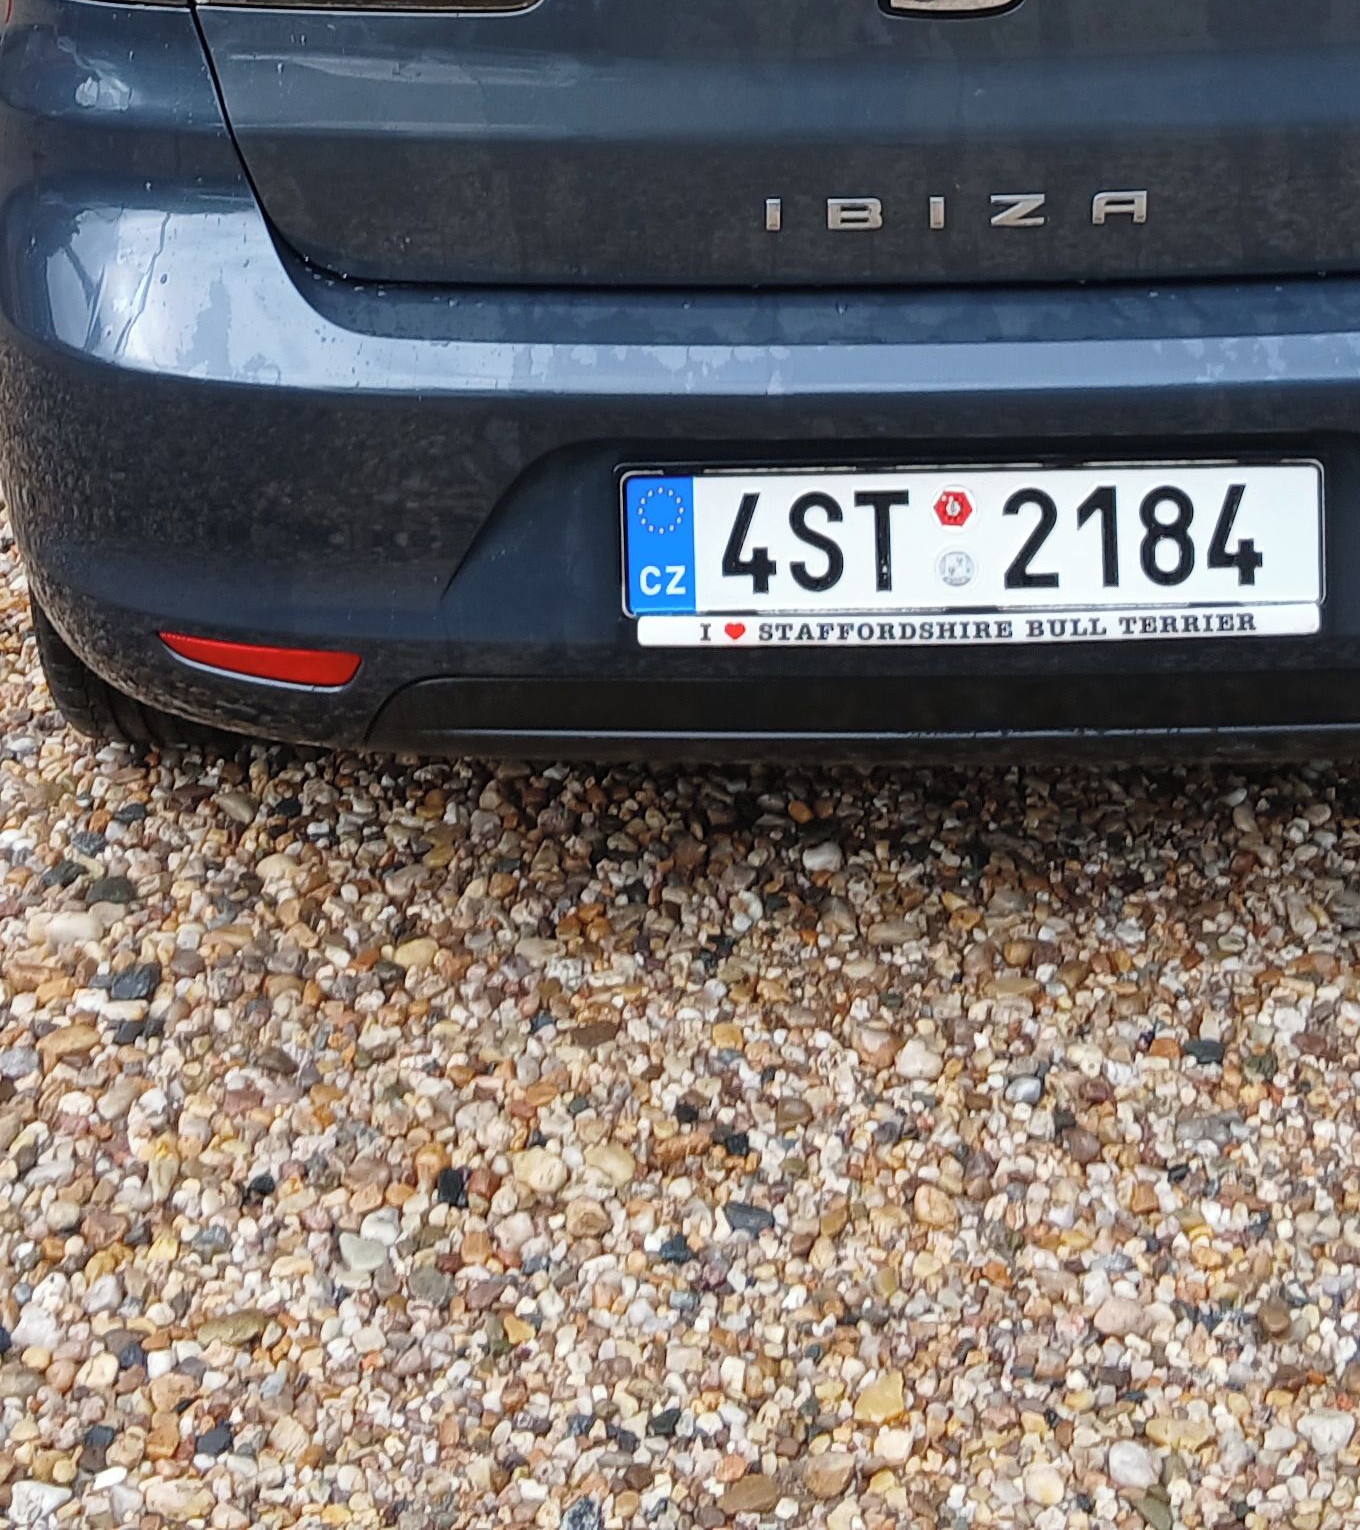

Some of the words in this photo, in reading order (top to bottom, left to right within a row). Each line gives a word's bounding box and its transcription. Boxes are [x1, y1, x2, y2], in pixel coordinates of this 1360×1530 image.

[765, 190, 1148, 231] IBIZA
[721, 489, 909, 595] 4ST
[1002, 482, 1263, 590] 2184
[639, 565, 687, 596] CZ
[699, 623, 712, 641] I
[758, 620, 1013, 642] STAFFORDSHIRE
[1026, 617, 1107, 638] BULL
[1119, 612, 1256, 635] TERRIER
